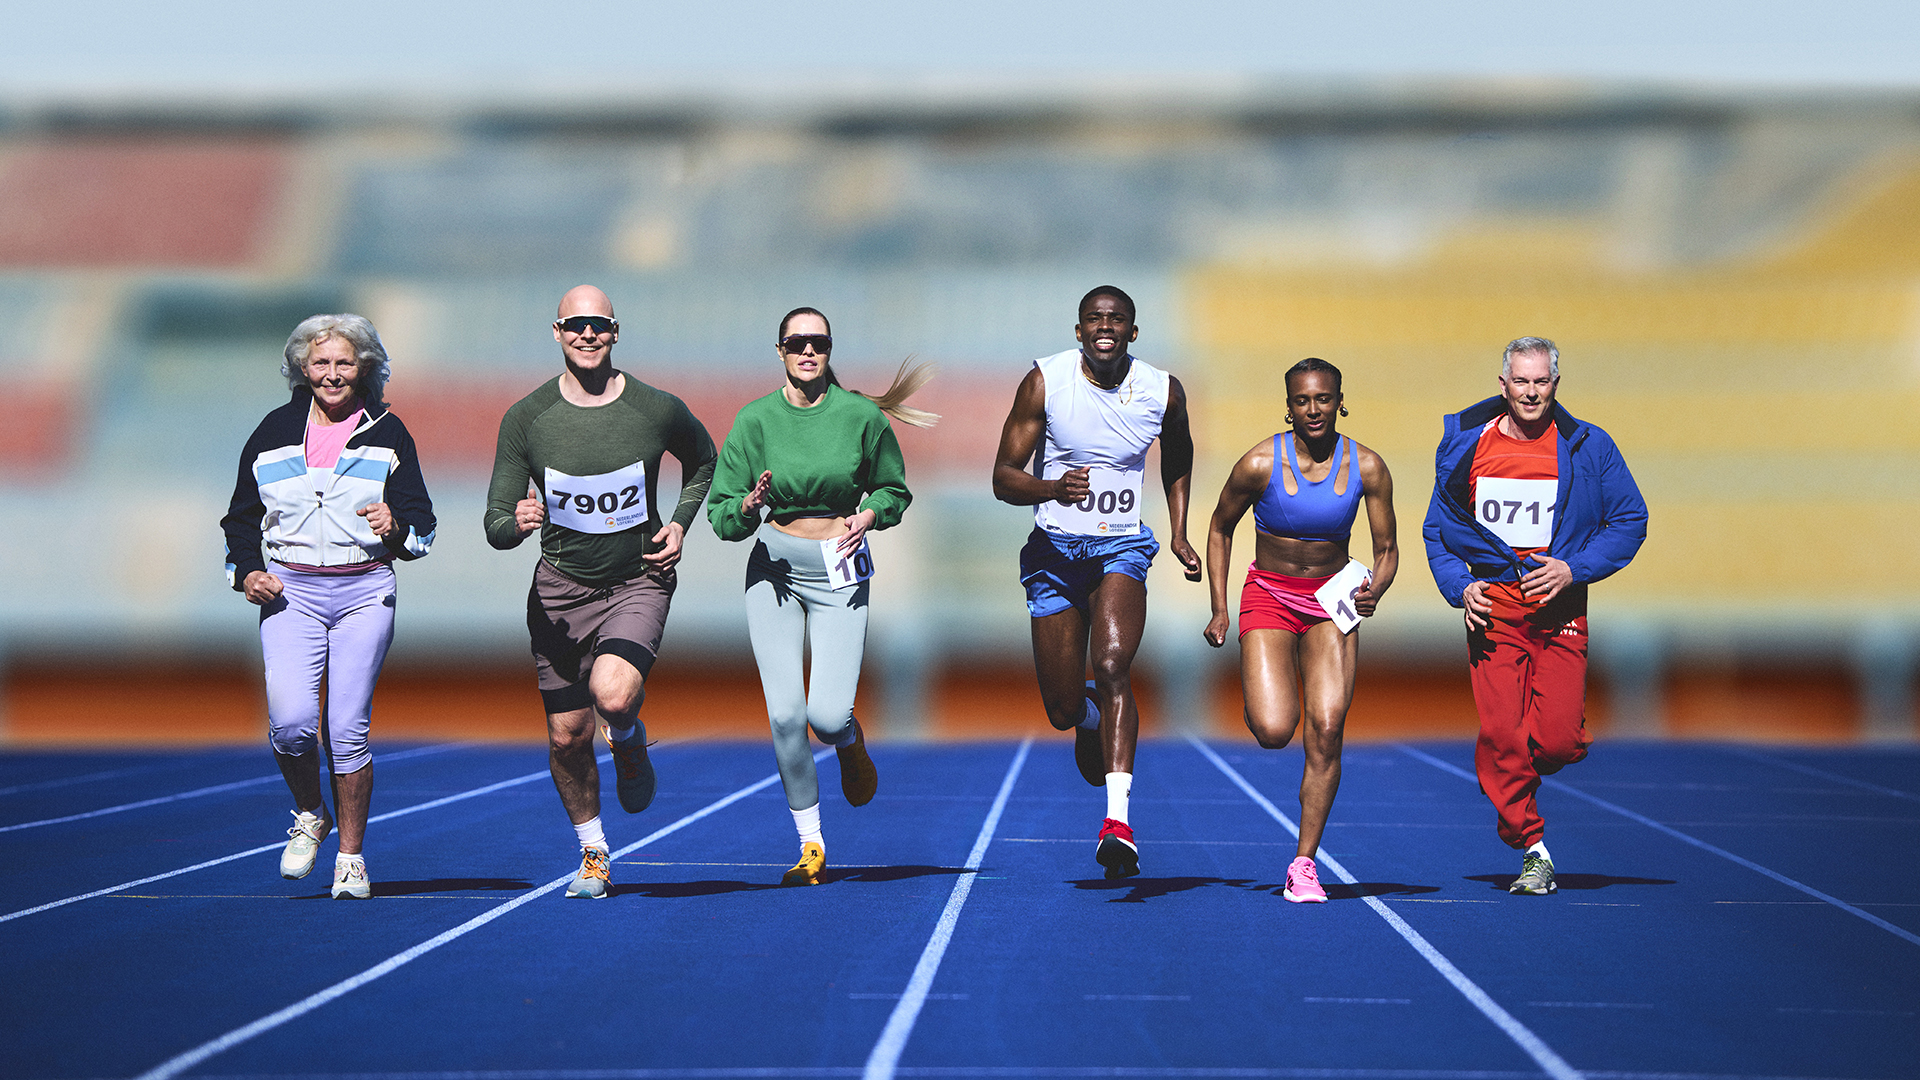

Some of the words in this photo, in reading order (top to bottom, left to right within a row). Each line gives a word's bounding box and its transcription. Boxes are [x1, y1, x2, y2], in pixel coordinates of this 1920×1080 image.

[552, 485, 640, 514] 7902
[1057, 489, 1135, 514] 009
[834, 553, 874, 582] 10
